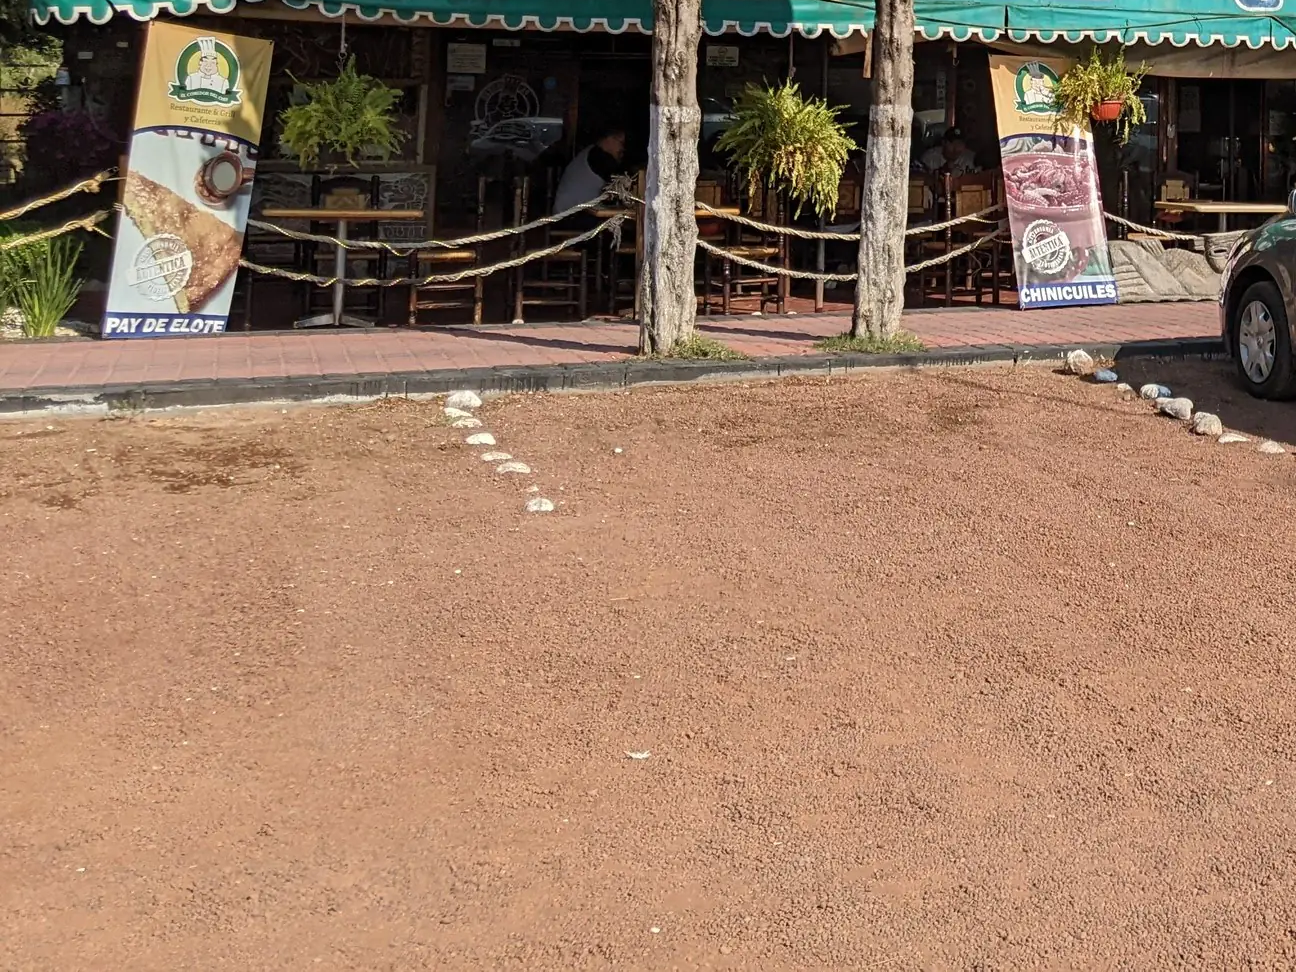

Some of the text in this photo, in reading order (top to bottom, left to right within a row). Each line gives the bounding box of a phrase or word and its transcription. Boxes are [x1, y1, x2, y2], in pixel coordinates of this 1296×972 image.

[170, 103, 213, 115] Restaurante
[220, 108, 236, 118] Grill
[1020, 284, 1116, 303] CHINICUILES
[105, 317, 225, 334] PAY DE ELOTE
